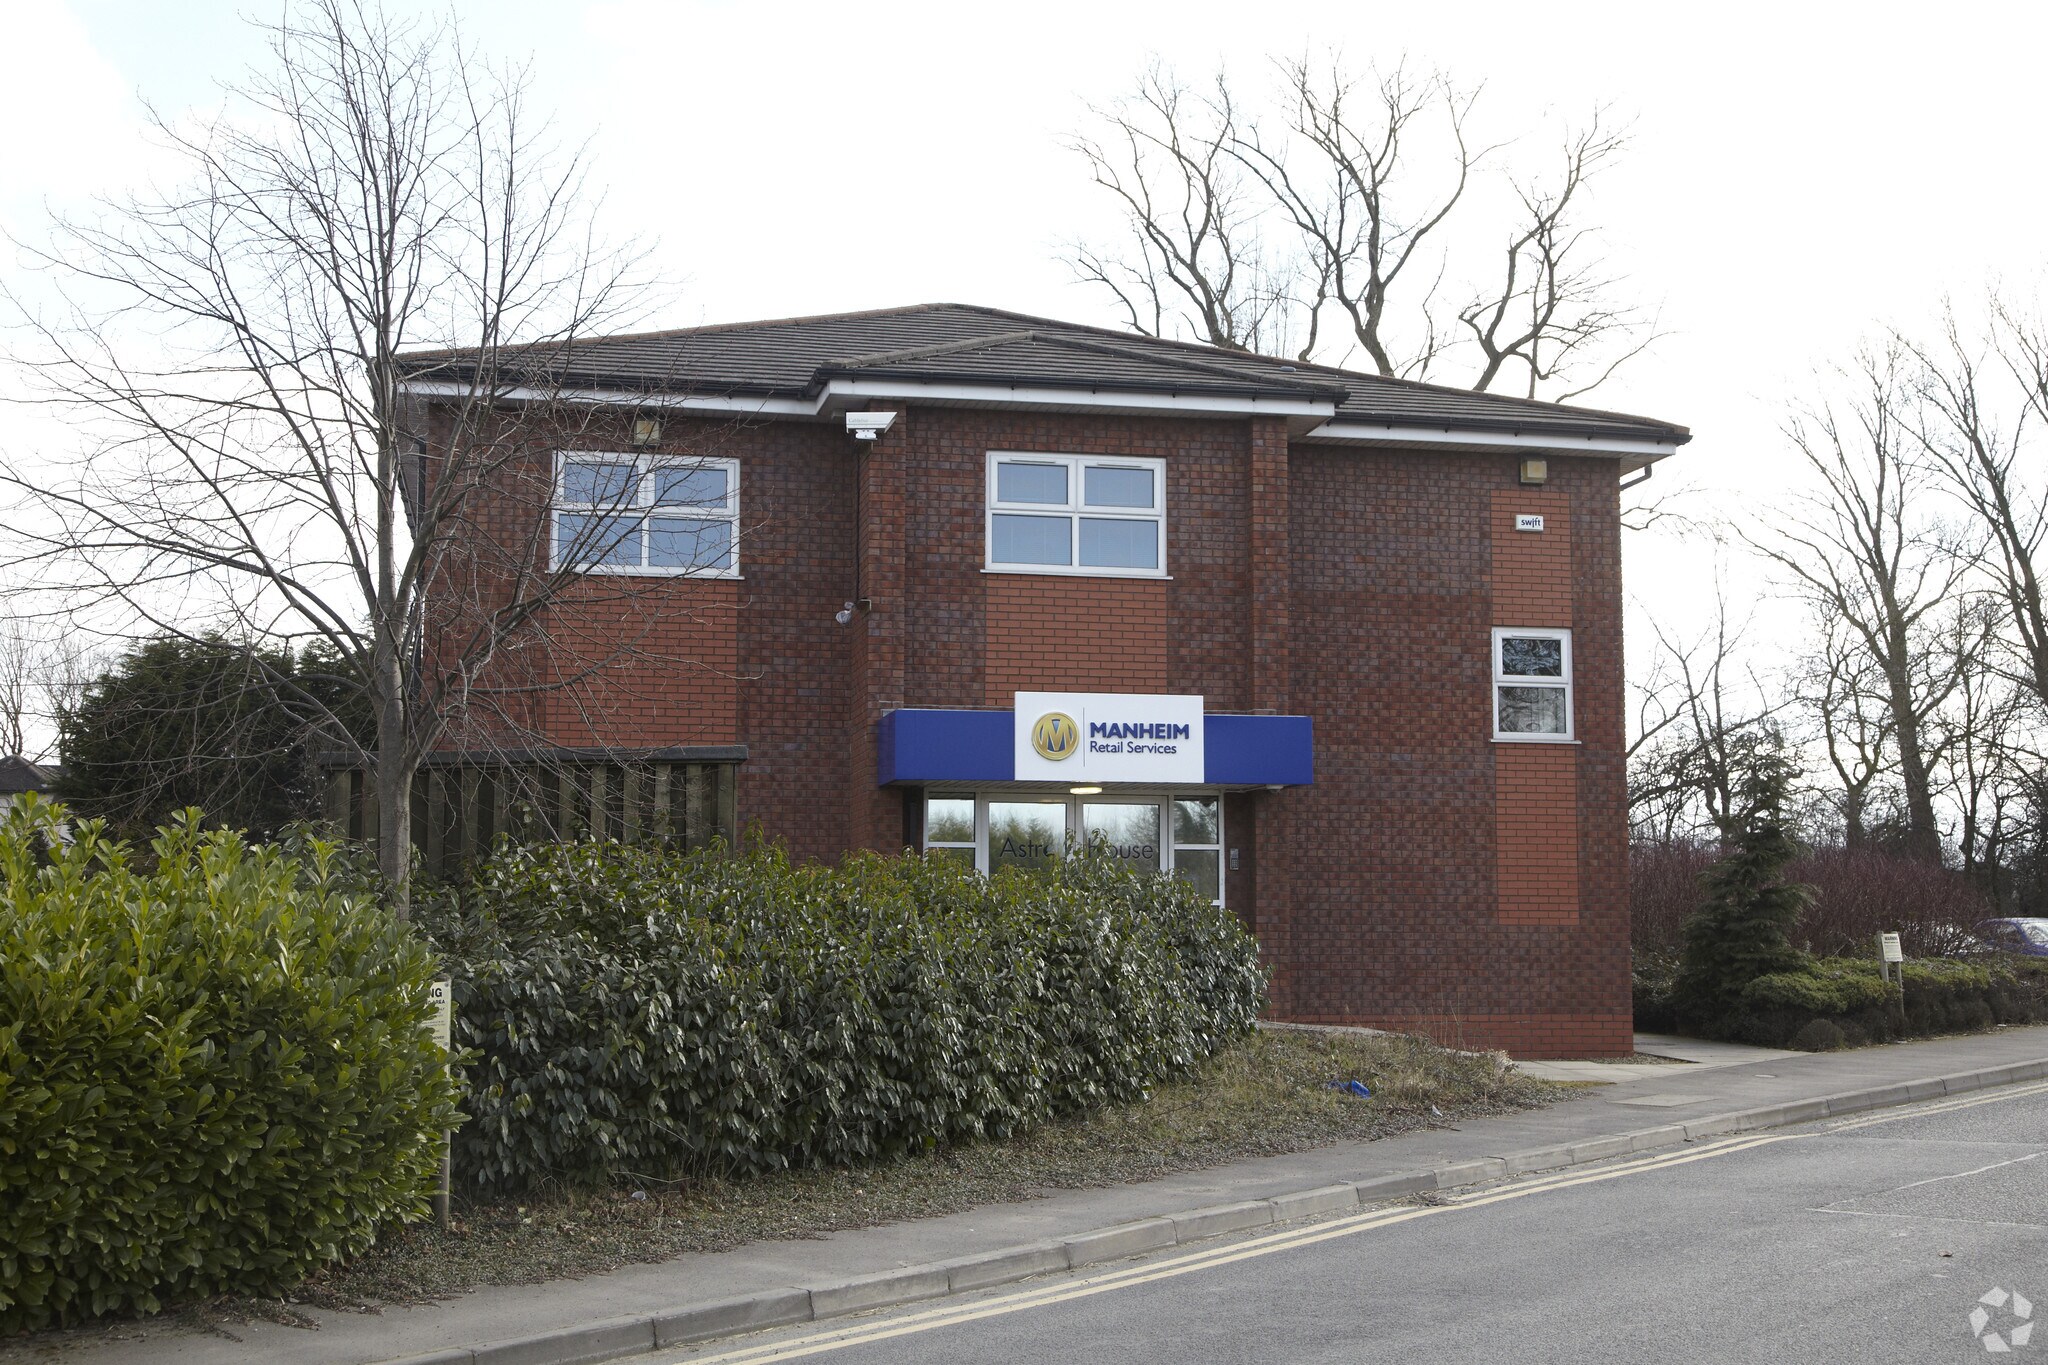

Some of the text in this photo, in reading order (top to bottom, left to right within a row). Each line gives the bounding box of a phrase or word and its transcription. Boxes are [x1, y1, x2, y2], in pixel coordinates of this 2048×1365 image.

[1521, 517, 1541, 528] swift
[1090, 722, 1189, 740] MANHEIM
[1090, 741, 1177, 754] Retail Services
